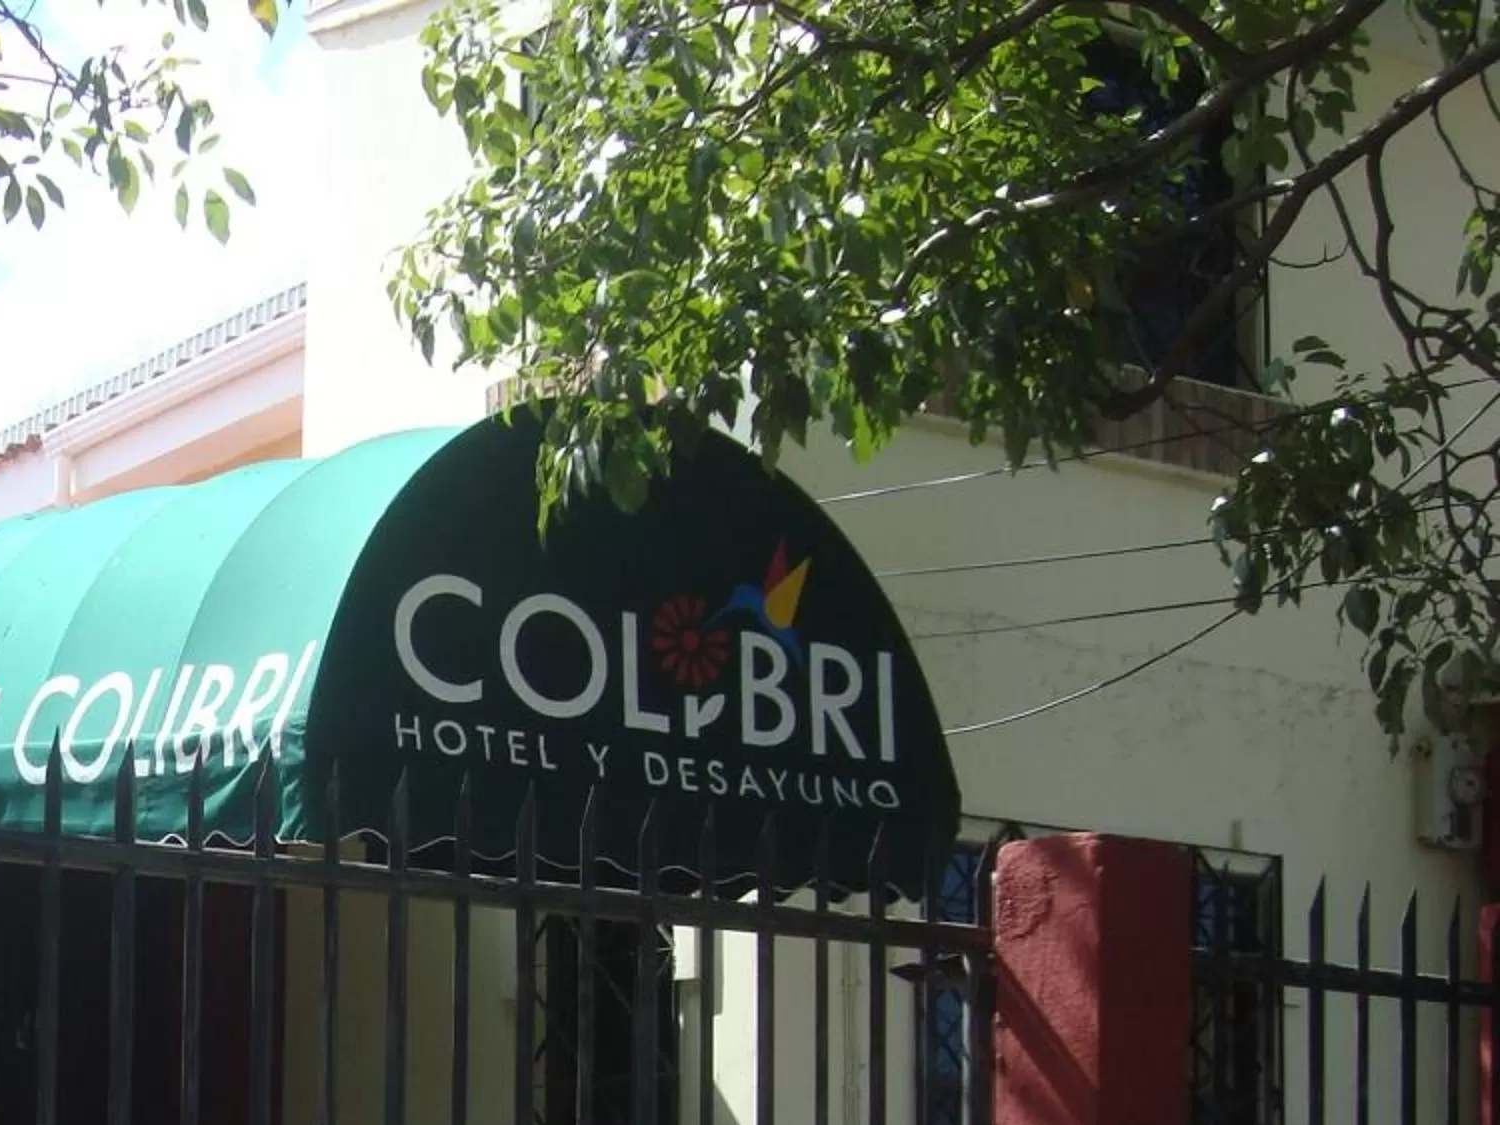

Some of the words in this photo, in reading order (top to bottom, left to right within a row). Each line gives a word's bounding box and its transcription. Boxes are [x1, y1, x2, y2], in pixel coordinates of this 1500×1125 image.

[12, 640, 317, 785] COLIBRI
[395, 713, 557, 770] HOTEL
[589, 744, 611, 776] Y
[645, 751, 901, 809] DESAYUNO
